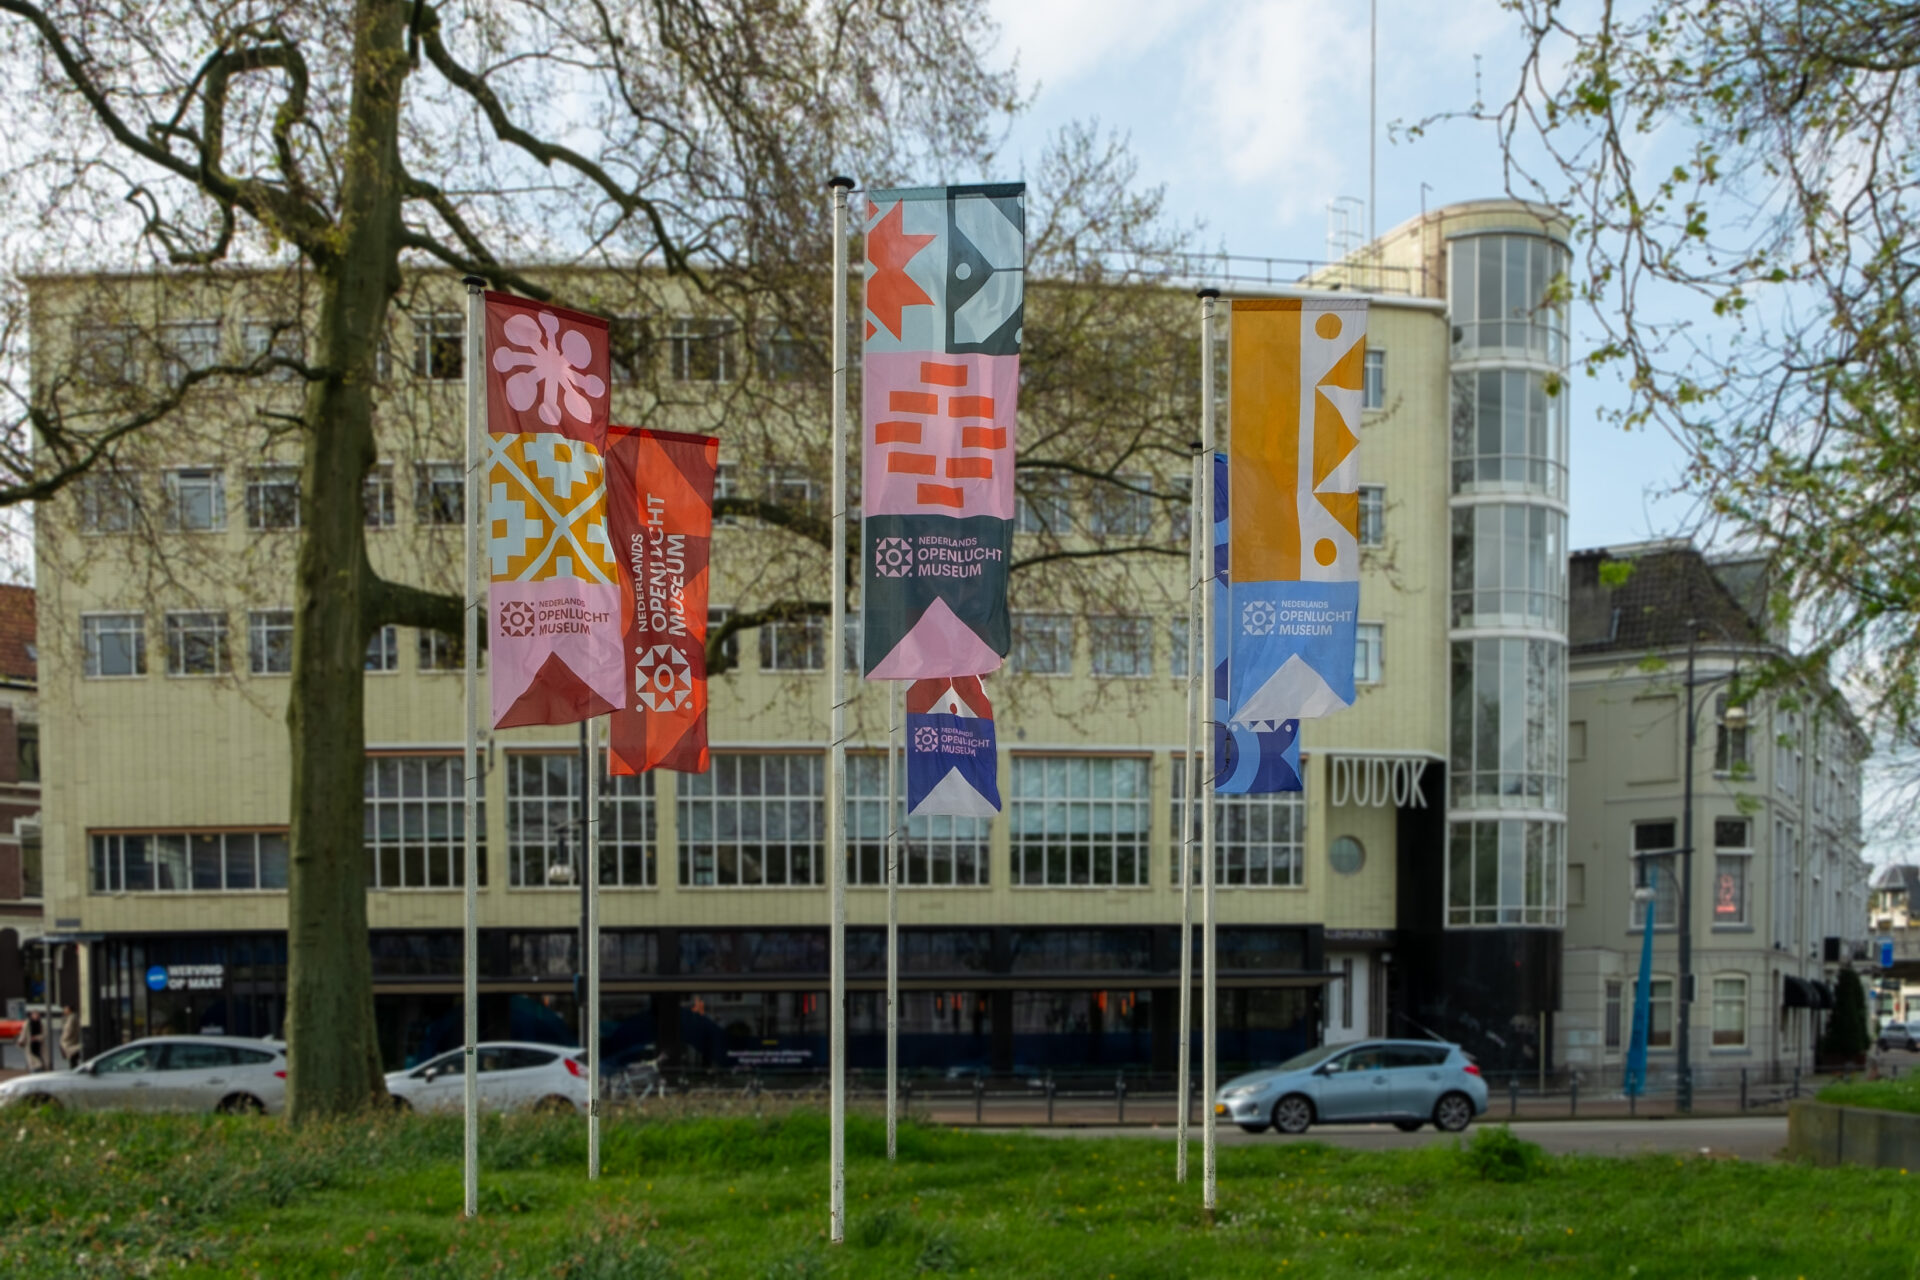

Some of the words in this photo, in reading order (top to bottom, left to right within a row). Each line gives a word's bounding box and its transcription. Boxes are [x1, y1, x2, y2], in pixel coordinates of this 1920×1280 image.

[919, 536, 977, 547] NEDERLANDS
[917, 547, 1002, 563] OPENLUCHT
[918, 564, 981, 578] MUSEUM
[631, 533, 648, 632] NEDERLANDS
[666, 534, 686, 637] MUSEUM
[539, 598, 585, 608] NEDERLANDS
[1281, 600, 1328, 609] NEDERLANDS
[538, 608, 609, 622] OPENLUCHT
[1280, 610, 1352, 622] OPENLUCHT
[539, 622, 590, 635] MUSEUM
[1280, 624, 1332, 635] MUSEUM
[1332, 757, 1428, 808] DUDOK
